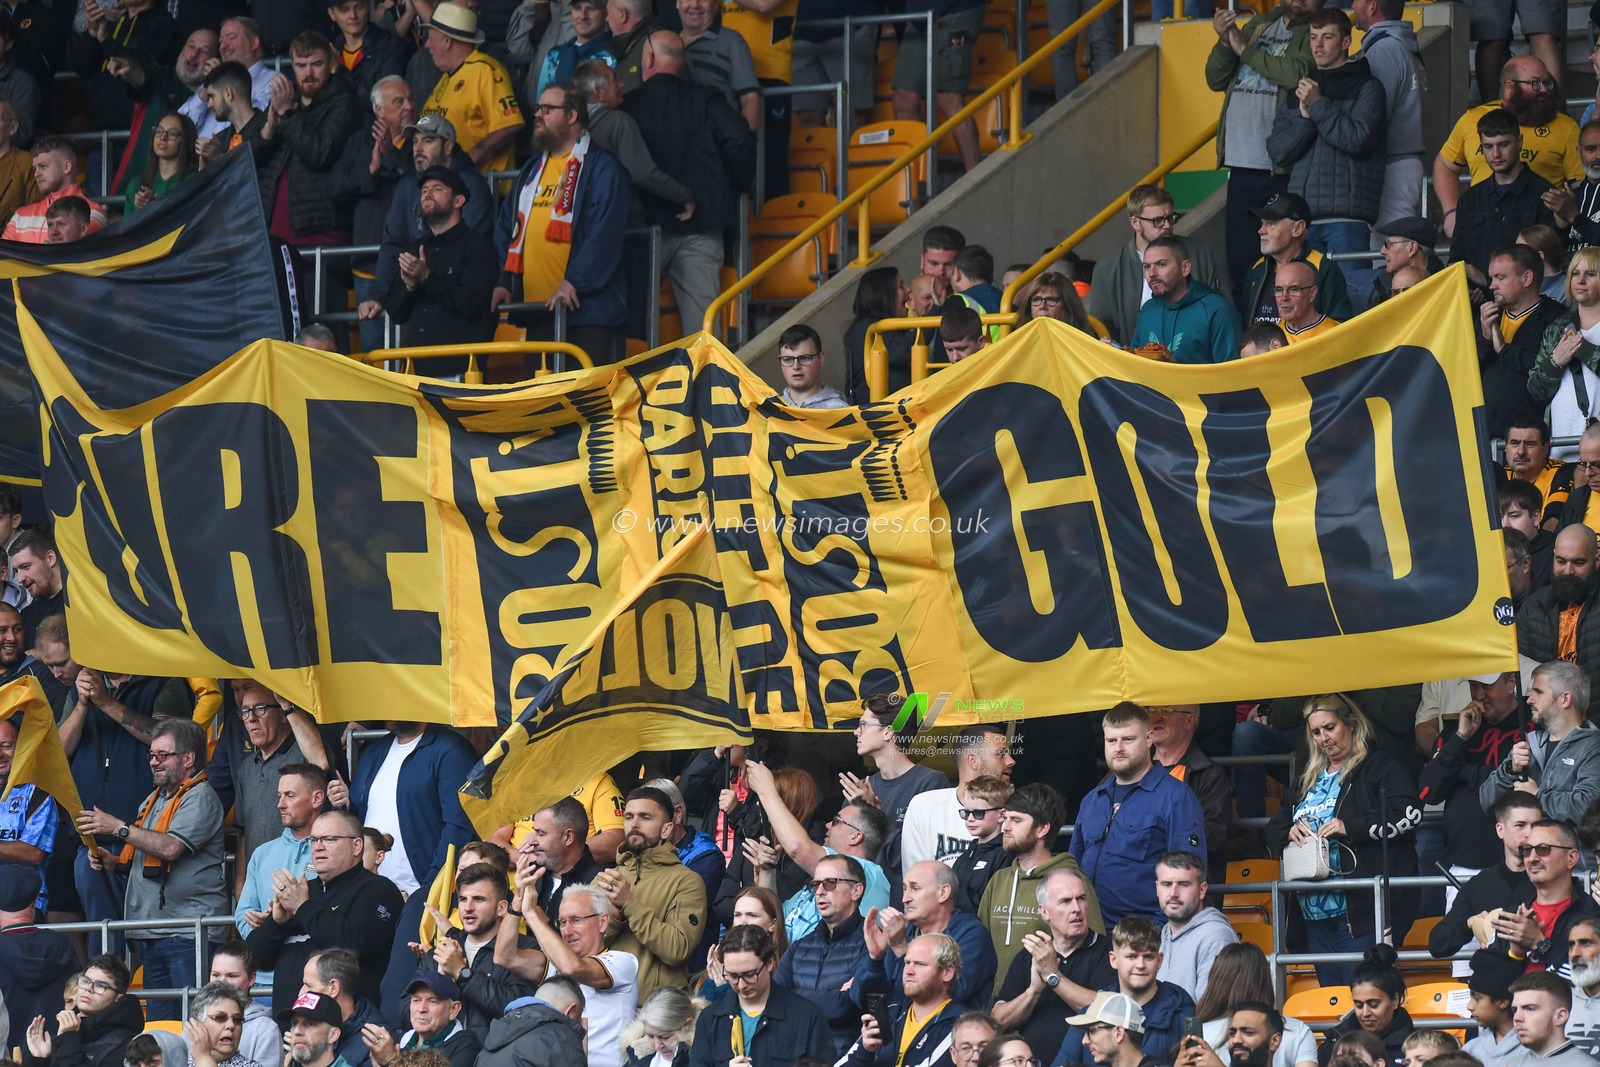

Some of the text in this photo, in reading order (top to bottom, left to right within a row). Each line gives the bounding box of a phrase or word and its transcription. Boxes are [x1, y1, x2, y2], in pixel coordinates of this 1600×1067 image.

[562, 163, 577, 209] WOLVES
[1261, 304, 1273, 313] the
[35, 393, 442, 669] PURE
[929, 345, 1479, 662] GOLD
